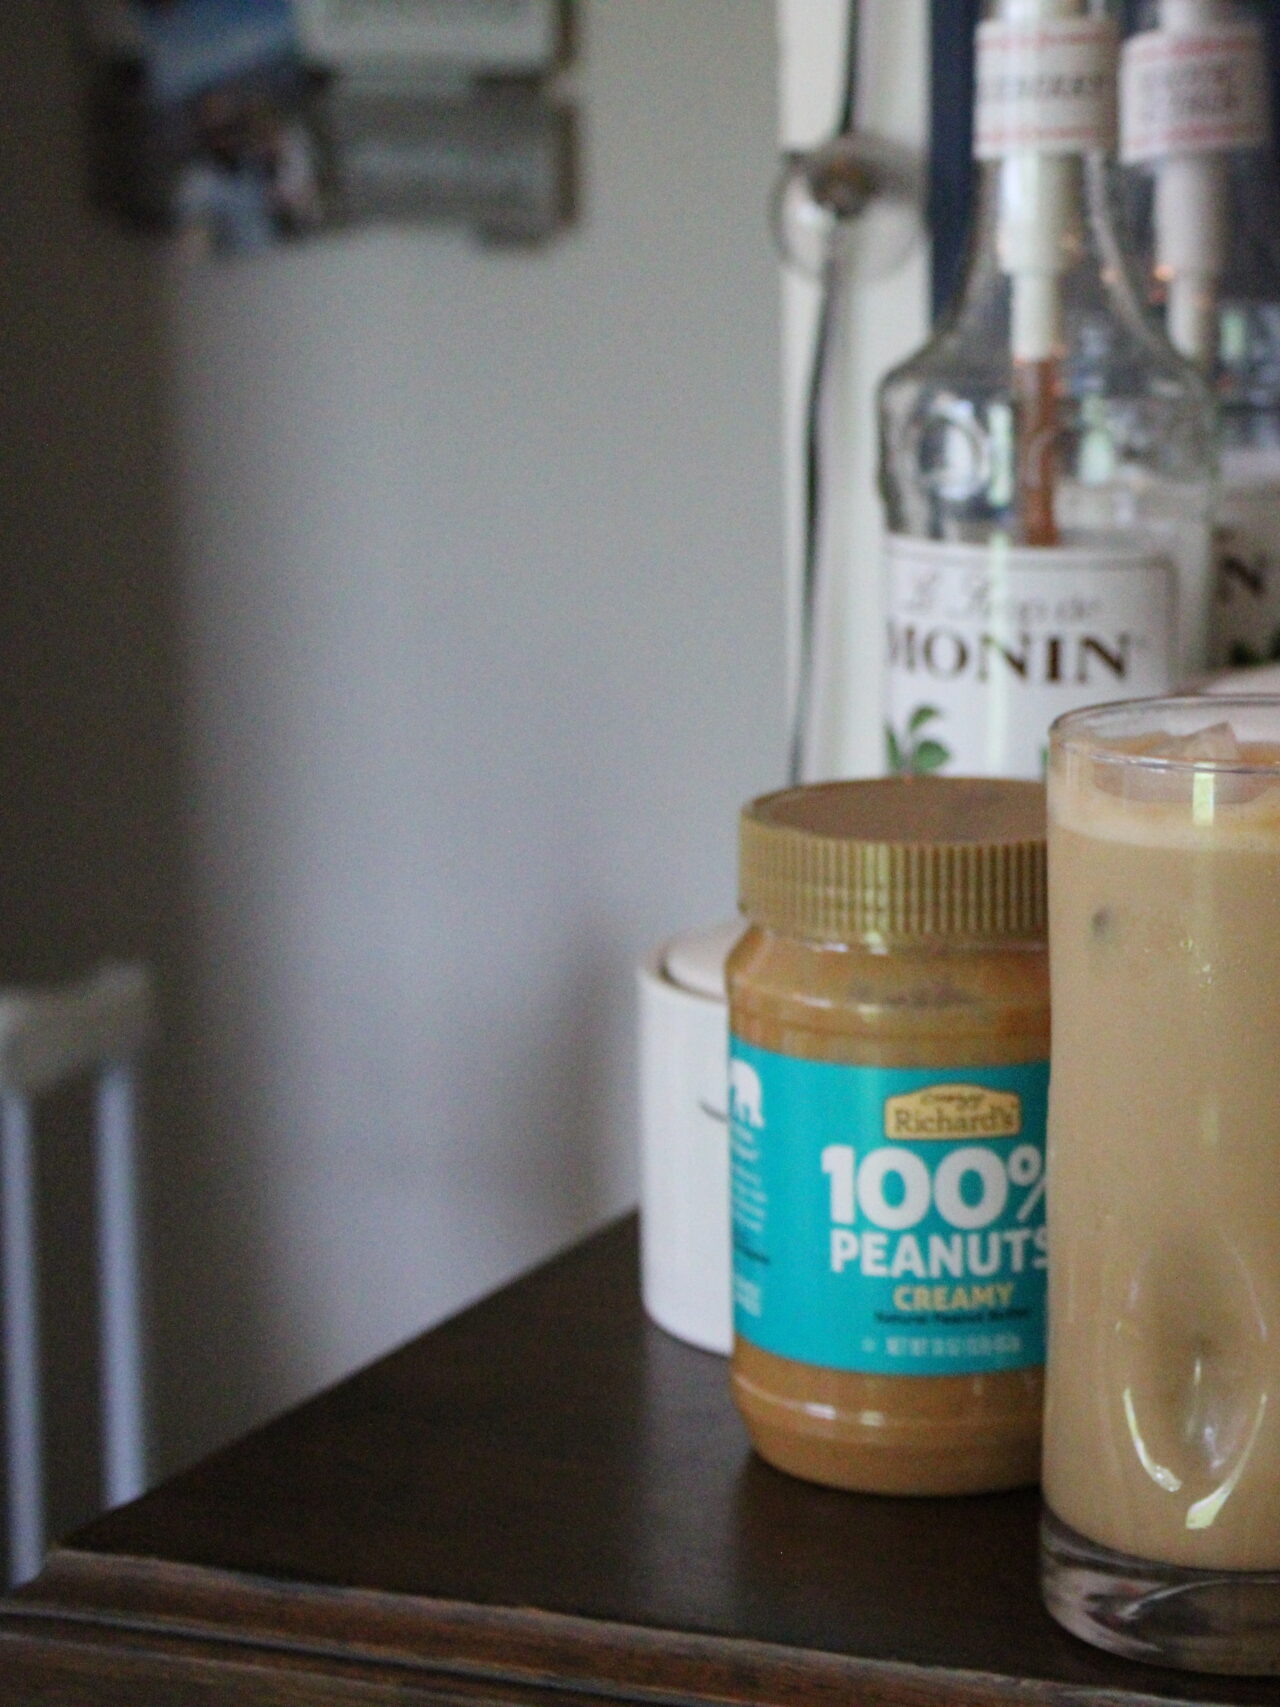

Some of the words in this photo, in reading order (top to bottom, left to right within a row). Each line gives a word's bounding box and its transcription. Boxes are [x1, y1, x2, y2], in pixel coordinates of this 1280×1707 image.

[894, 1102, 1019, 1133] Richard's
[831, 1226, 1047, 1279] PEANUTS
[892, 1282, 1015, 1311] CREAMY
